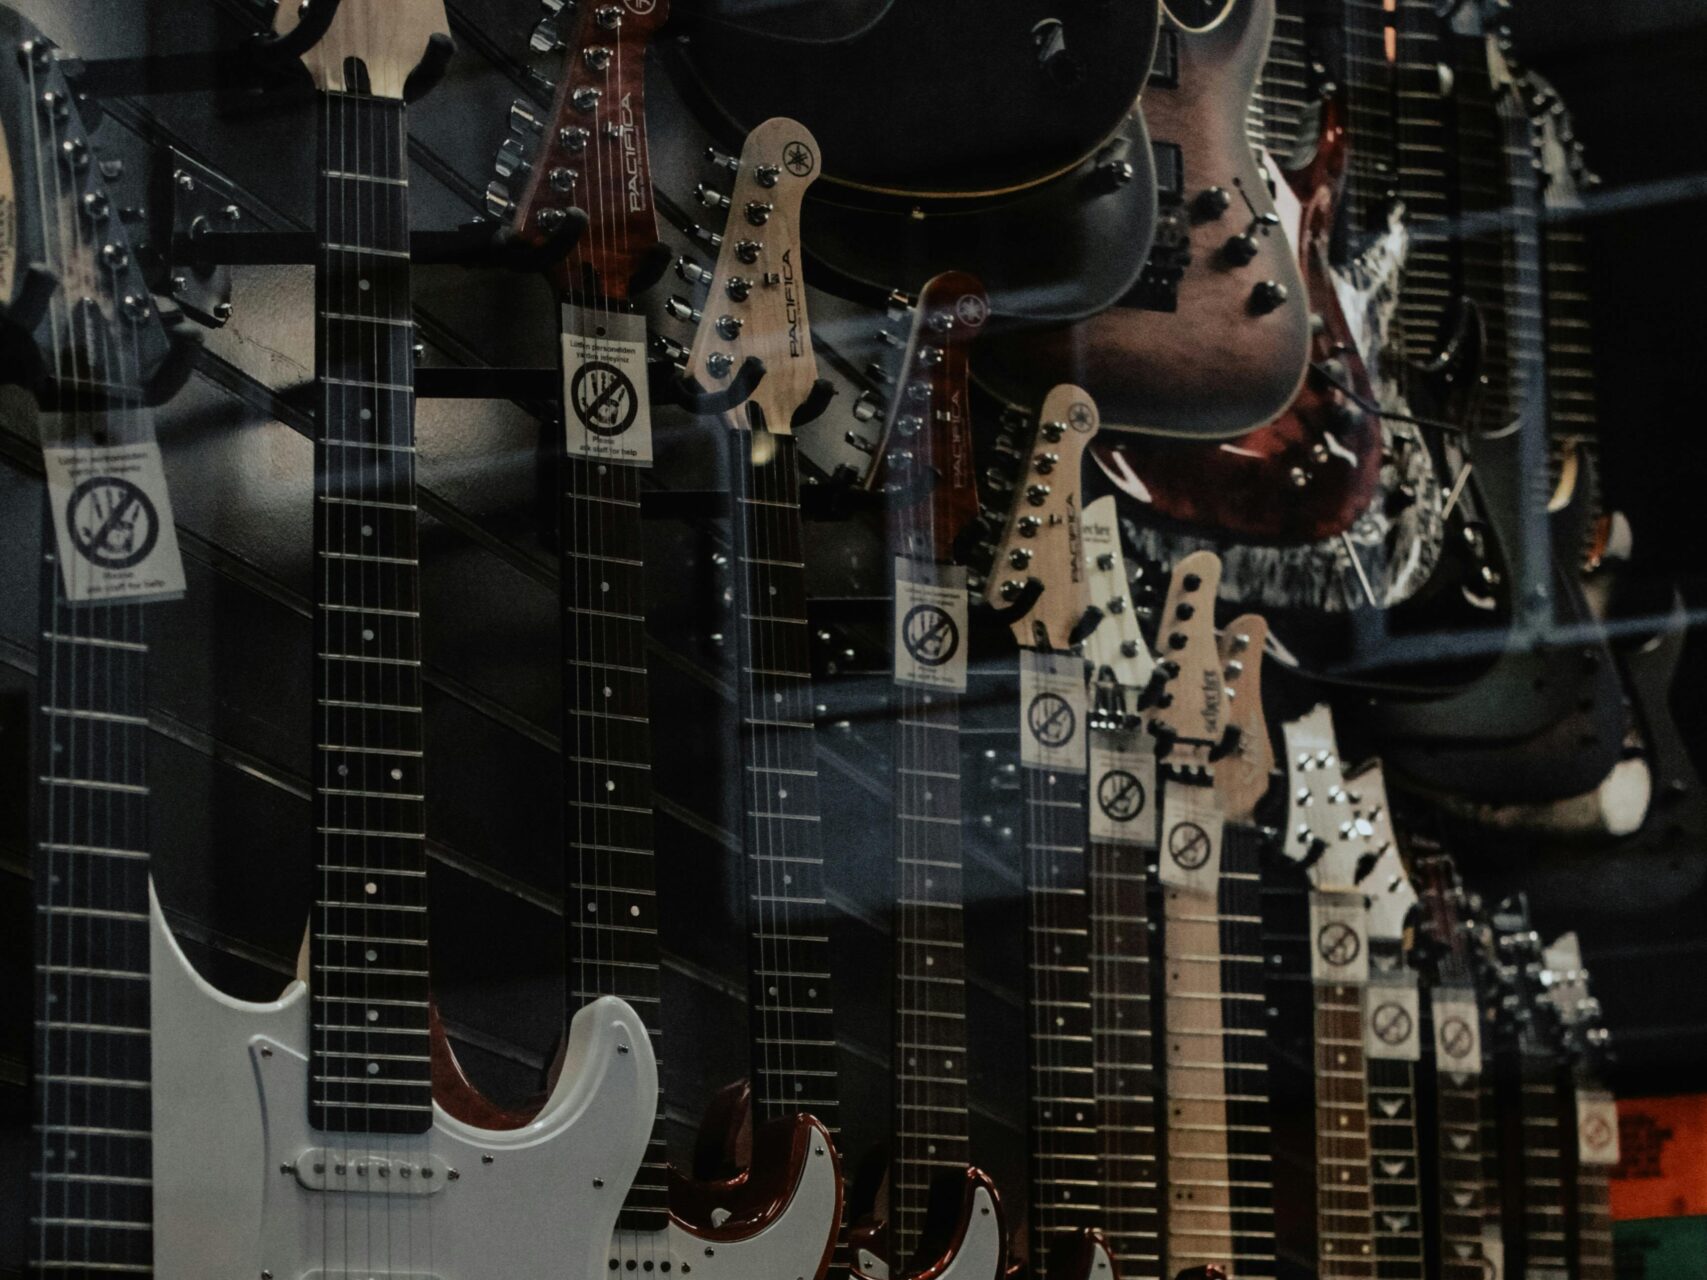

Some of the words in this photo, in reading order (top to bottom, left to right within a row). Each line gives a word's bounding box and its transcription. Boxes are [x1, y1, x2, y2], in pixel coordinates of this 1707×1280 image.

[621, 91, 641, 213] PACIFICA
[782, 248, 799, 358] PACIFICA
[951, 389, 962, 488] PACIFICA
